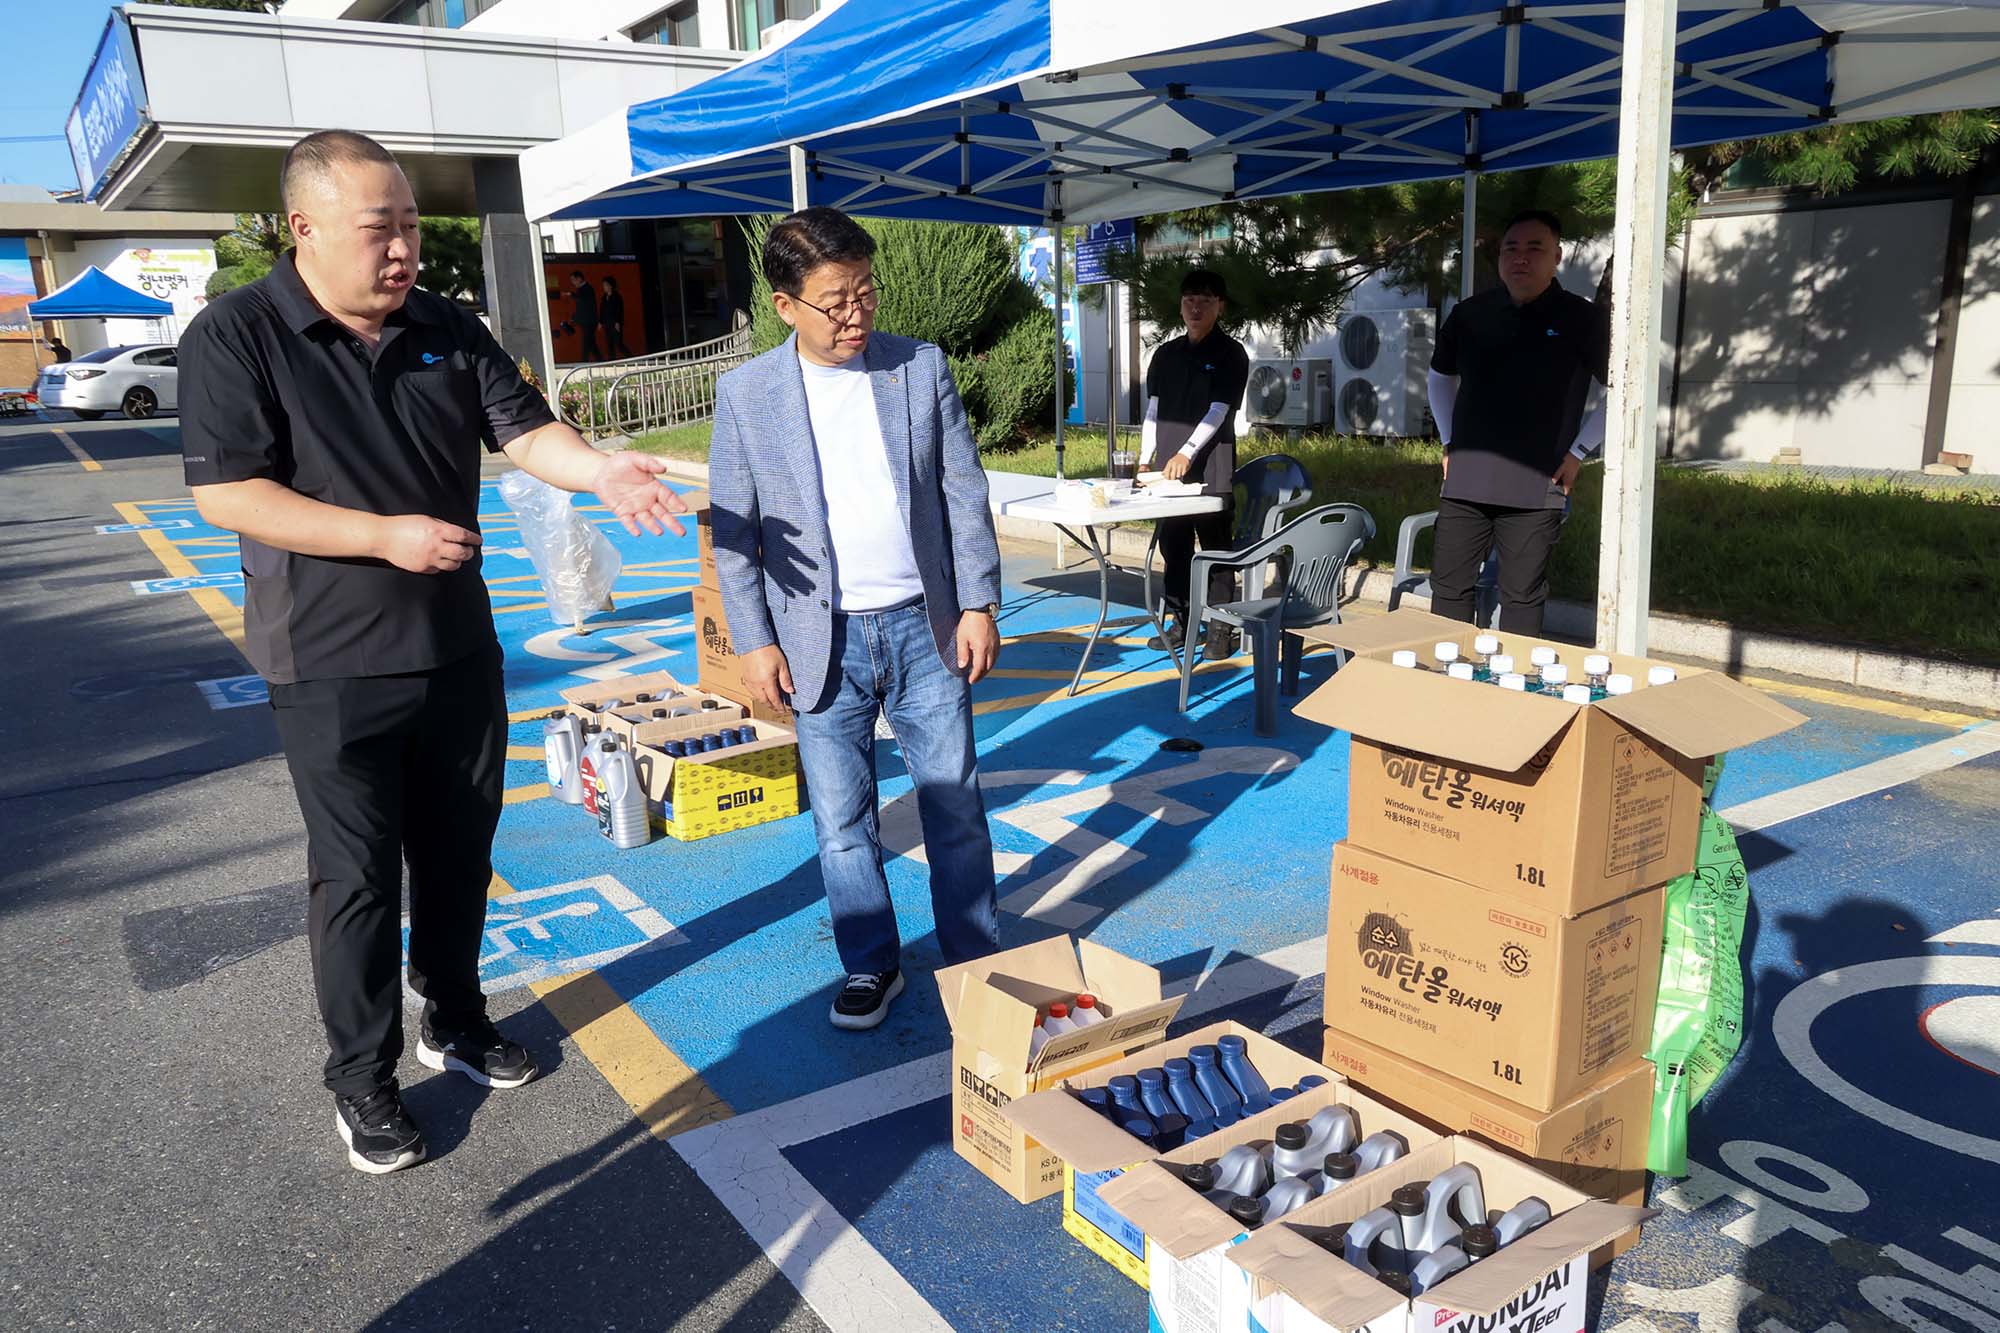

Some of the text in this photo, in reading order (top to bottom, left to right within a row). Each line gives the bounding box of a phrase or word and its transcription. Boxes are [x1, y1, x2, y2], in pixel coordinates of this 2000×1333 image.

[1291, 384, 1301, 392] LG
[705, 635, 728, 656] 에탄올
[1386, 758, 1525, 823] 에탄올 워셔액
[1384, 797, 1444, 822] Window Washer
[1384, 810, 1461, 841] 자동차유리 전용세정제
[1340, 863, 1380, 886] 사계절용
[1515, 863, 1546, 888] 1.8L
[1371, 926, 1399, 948] 순수
[1363, 951, 1449, 1004] 에탄올
[1446, 988, 1502, 1022] 워셔액
[1361, 985, 1420, 1014] Window Washer
[1360, 997, 1437, 1034] 자동차유리 전용세정제
[1330, 1050, 1368, 1075] 사계절용
[1492, 1060, 1523, 1085] 1.8L
[1449, 1262, 1570, 1333] YUNDAI
[1436, 1310, 1454, 1324] Pre
